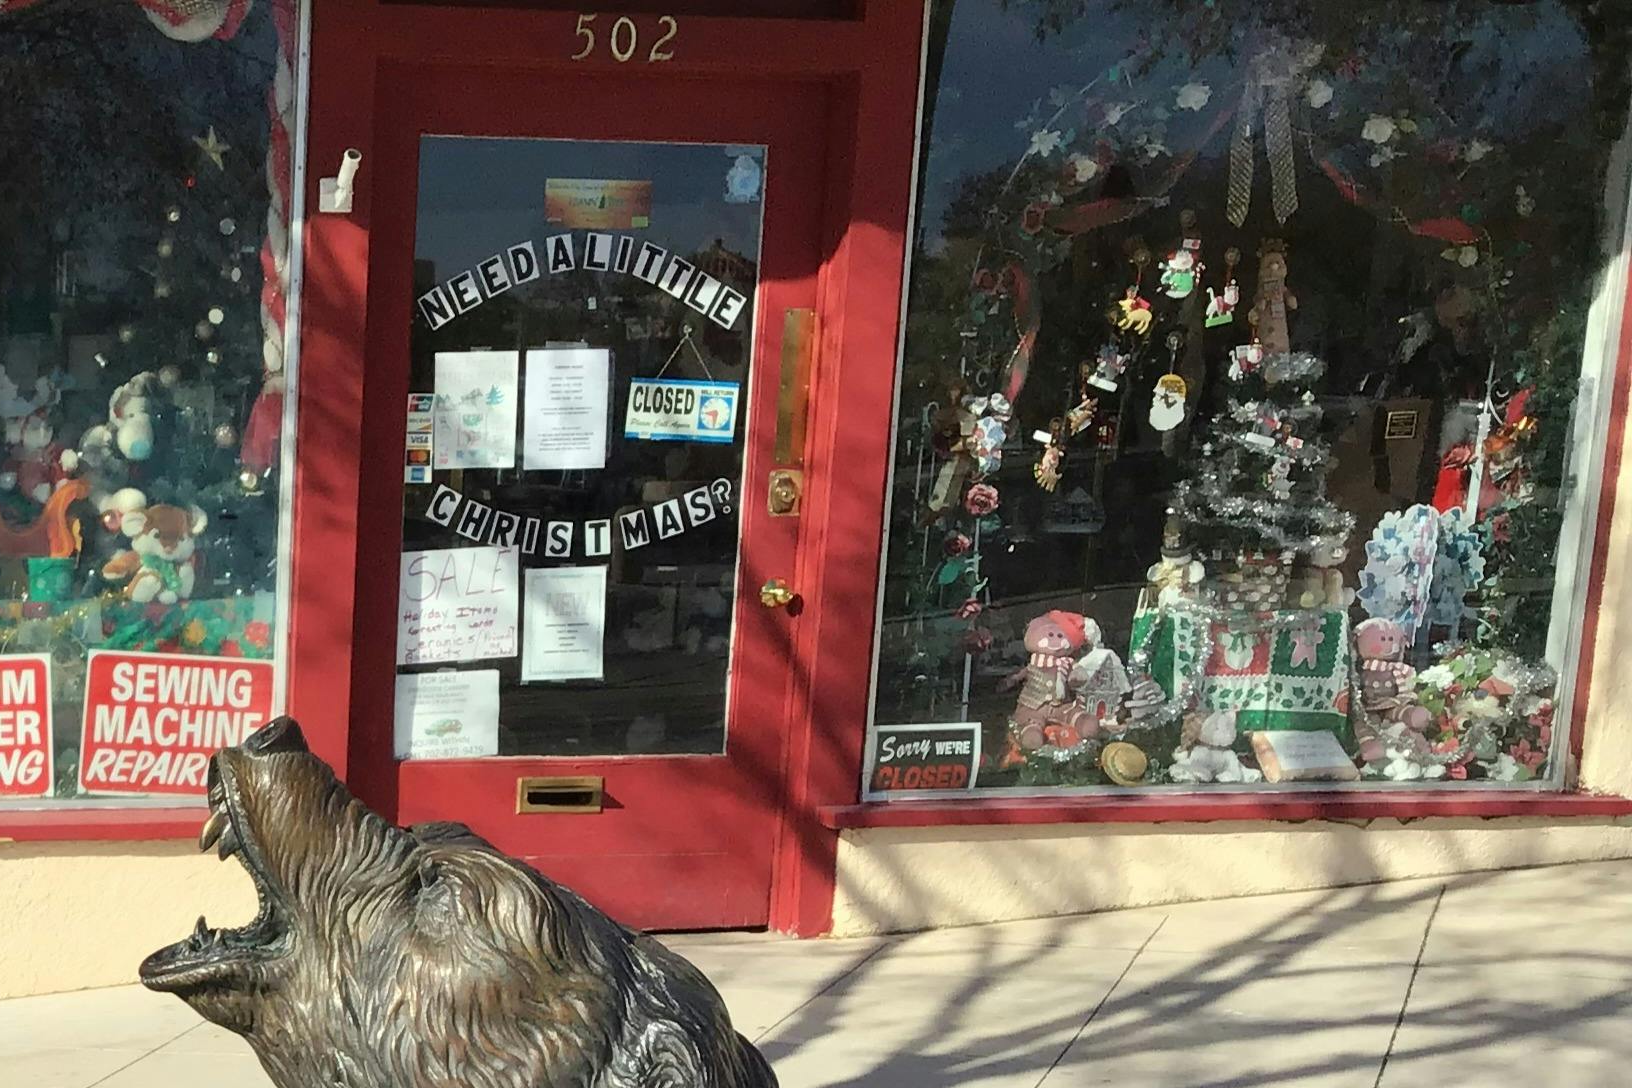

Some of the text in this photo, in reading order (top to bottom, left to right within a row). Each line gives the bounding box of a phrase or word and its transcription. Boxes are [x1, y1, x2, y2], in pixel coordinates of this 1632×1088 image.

[570, 12, 679, 63] 502
[418, 233, 747, 331] NEED A LITTLE
[632, 385, 696, 416] CLOSED
[410, 435, 429, 443] VISA
[425, 478, 732, 558] CHRISTMAS?
[404, 549, 512, 602] SALE
[110, 662, 253, 708] SEWING
[93, 704, 264, 749] MACHINE
[879, 735, 971, 763] Sorry WE'RE
[85, 749, 209, 786] REPAIR
[875, 763, 968, 790] CLOSED
